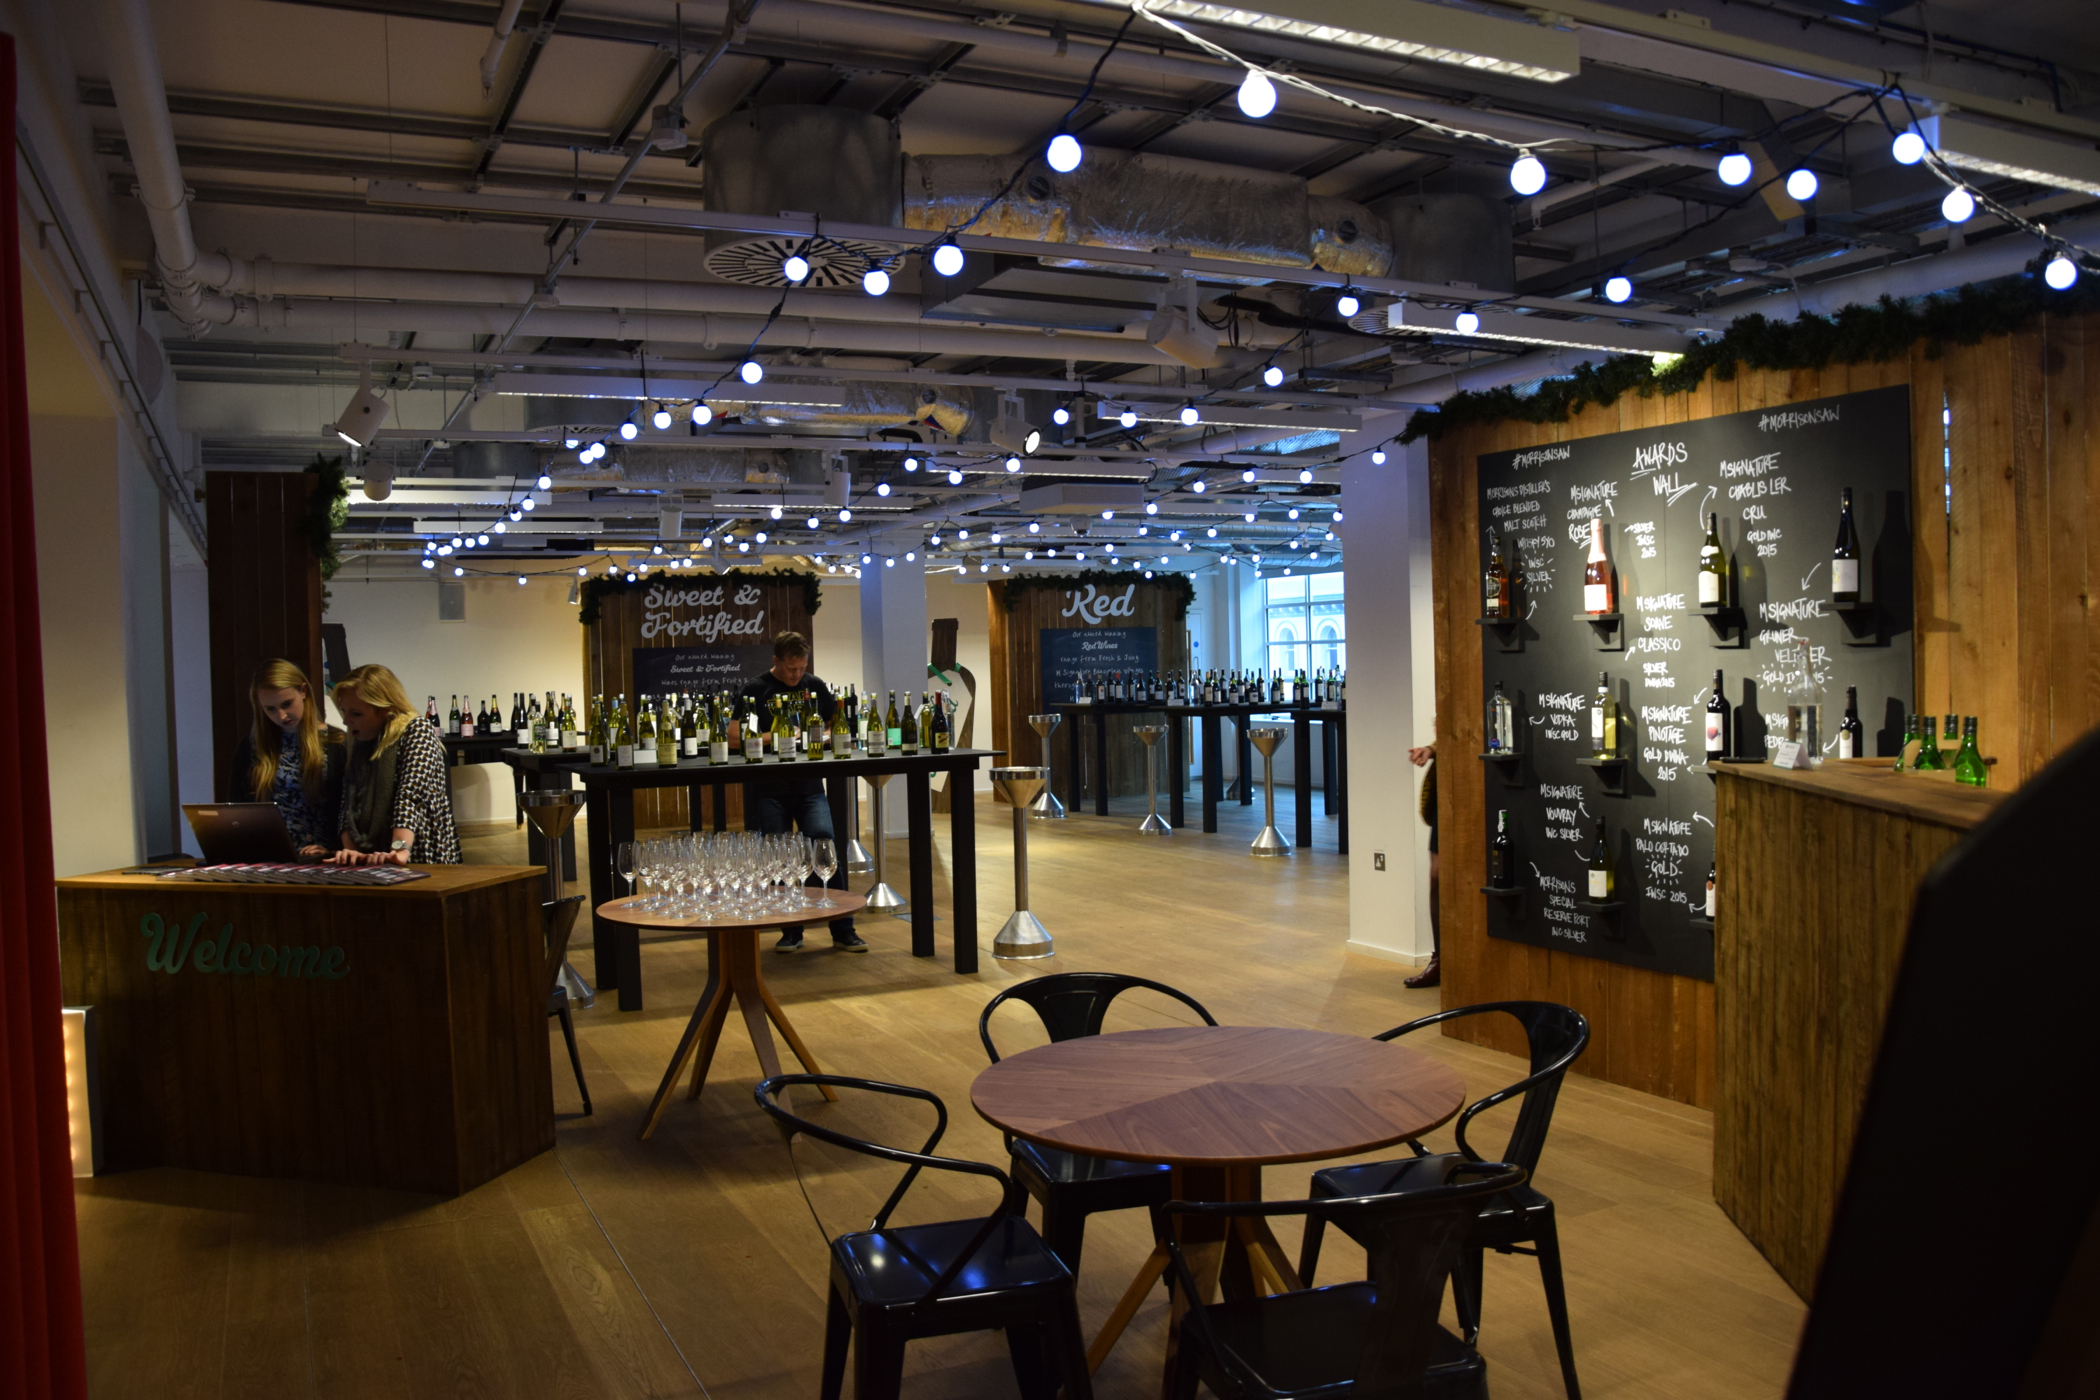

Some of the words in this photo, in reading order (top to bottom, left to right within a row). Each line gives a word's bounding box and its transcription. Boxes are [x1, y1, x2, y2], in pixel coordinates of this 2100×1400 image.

[1632, 441, 1688, 471] AWARDS
[1652, 471, 1690, 497] WALL
[1743, 504, 1767, 524] CRU
[1747, 531, 1767, 545] GOLD
[1640, 547, 1658, 559] 2015
[1757, 543, 1778, 558] 2015
[644, 583, 725, 608] Sweet
[734, 584, 761, 606] &
[1062, 583, 1136, 625] Red
[641, 610, 765, 643] Fortified
[1644, 615, 1673, 632] SOAVE
[1081, 641, 1097, 651] Red
[1097, 640, 1118, 650] Wines
[1638, 637, 1681, 654] CLASSICO
[670, 664, 694, 674] Sweet
[705, 663, 741, 674] Fortified
[1643, 661, 1668, 676] SILVER
[1762, 670, 1785, 686] GOLD
[1549, 713, 1577, 727] VODKA
[1648, 725, 1687, 745] PINOTAGE
[1643, 746, 1662, 763] GOLD
[1657, 765, 1678, 782] 2015
[1651, 860, 1678, 879] GOLD
[1669, 890, 1688, 904] 2015
[139, 911, 350, 980] Welcome
